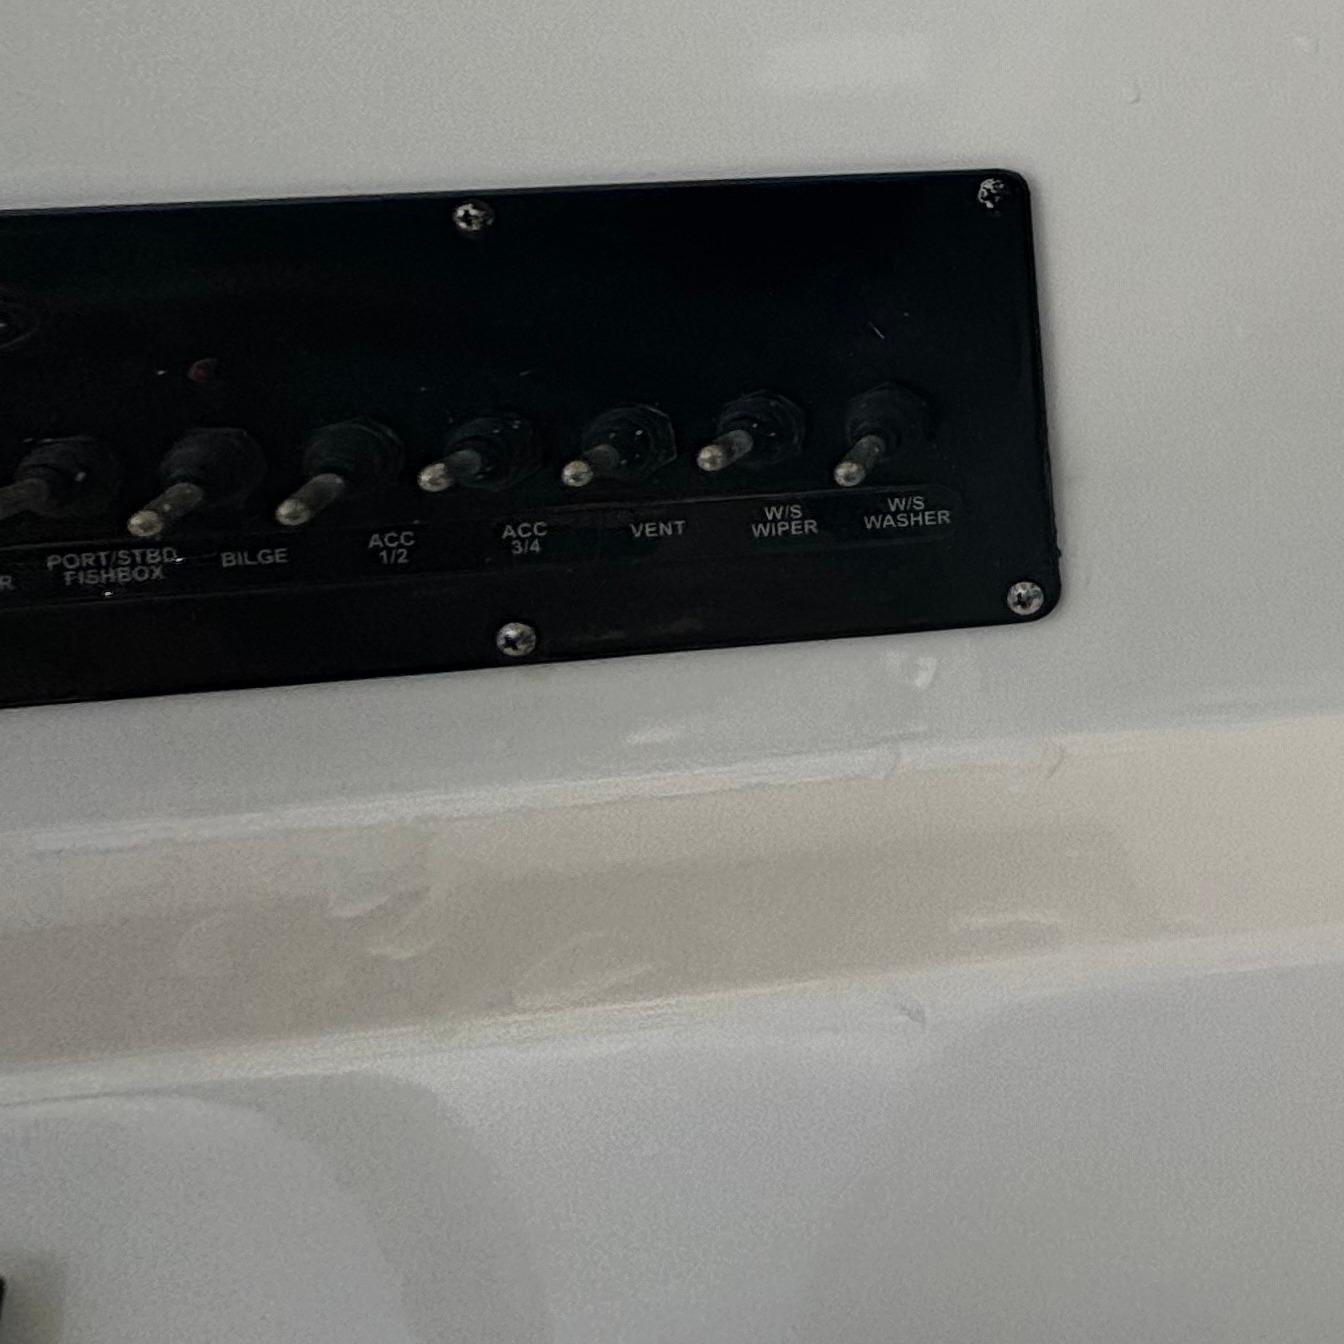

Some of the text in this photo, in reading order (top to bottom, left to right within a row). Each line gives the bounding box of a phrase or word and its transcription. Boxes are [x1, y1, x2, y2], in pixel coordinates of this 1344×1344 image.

[764, 503, 803, 521] W/S
[885, 495, 926, 513] W/S
[628, 519, 687, 539] VENT
[751, 519, 818, 538] WIPER
[863, 510, 951, 530] WASHER
[501, 520, 548, 540] ACC
[368, 531, 416, 550] ACC
[510, 537, 541, 555] 3/4
[46, 548, 178, 571] PORT/STBD
[221, 547, 289, 568] BILGE
[379, 549, 409, 566] 1/2
[63, 565, 165, 587] FISHBOX
